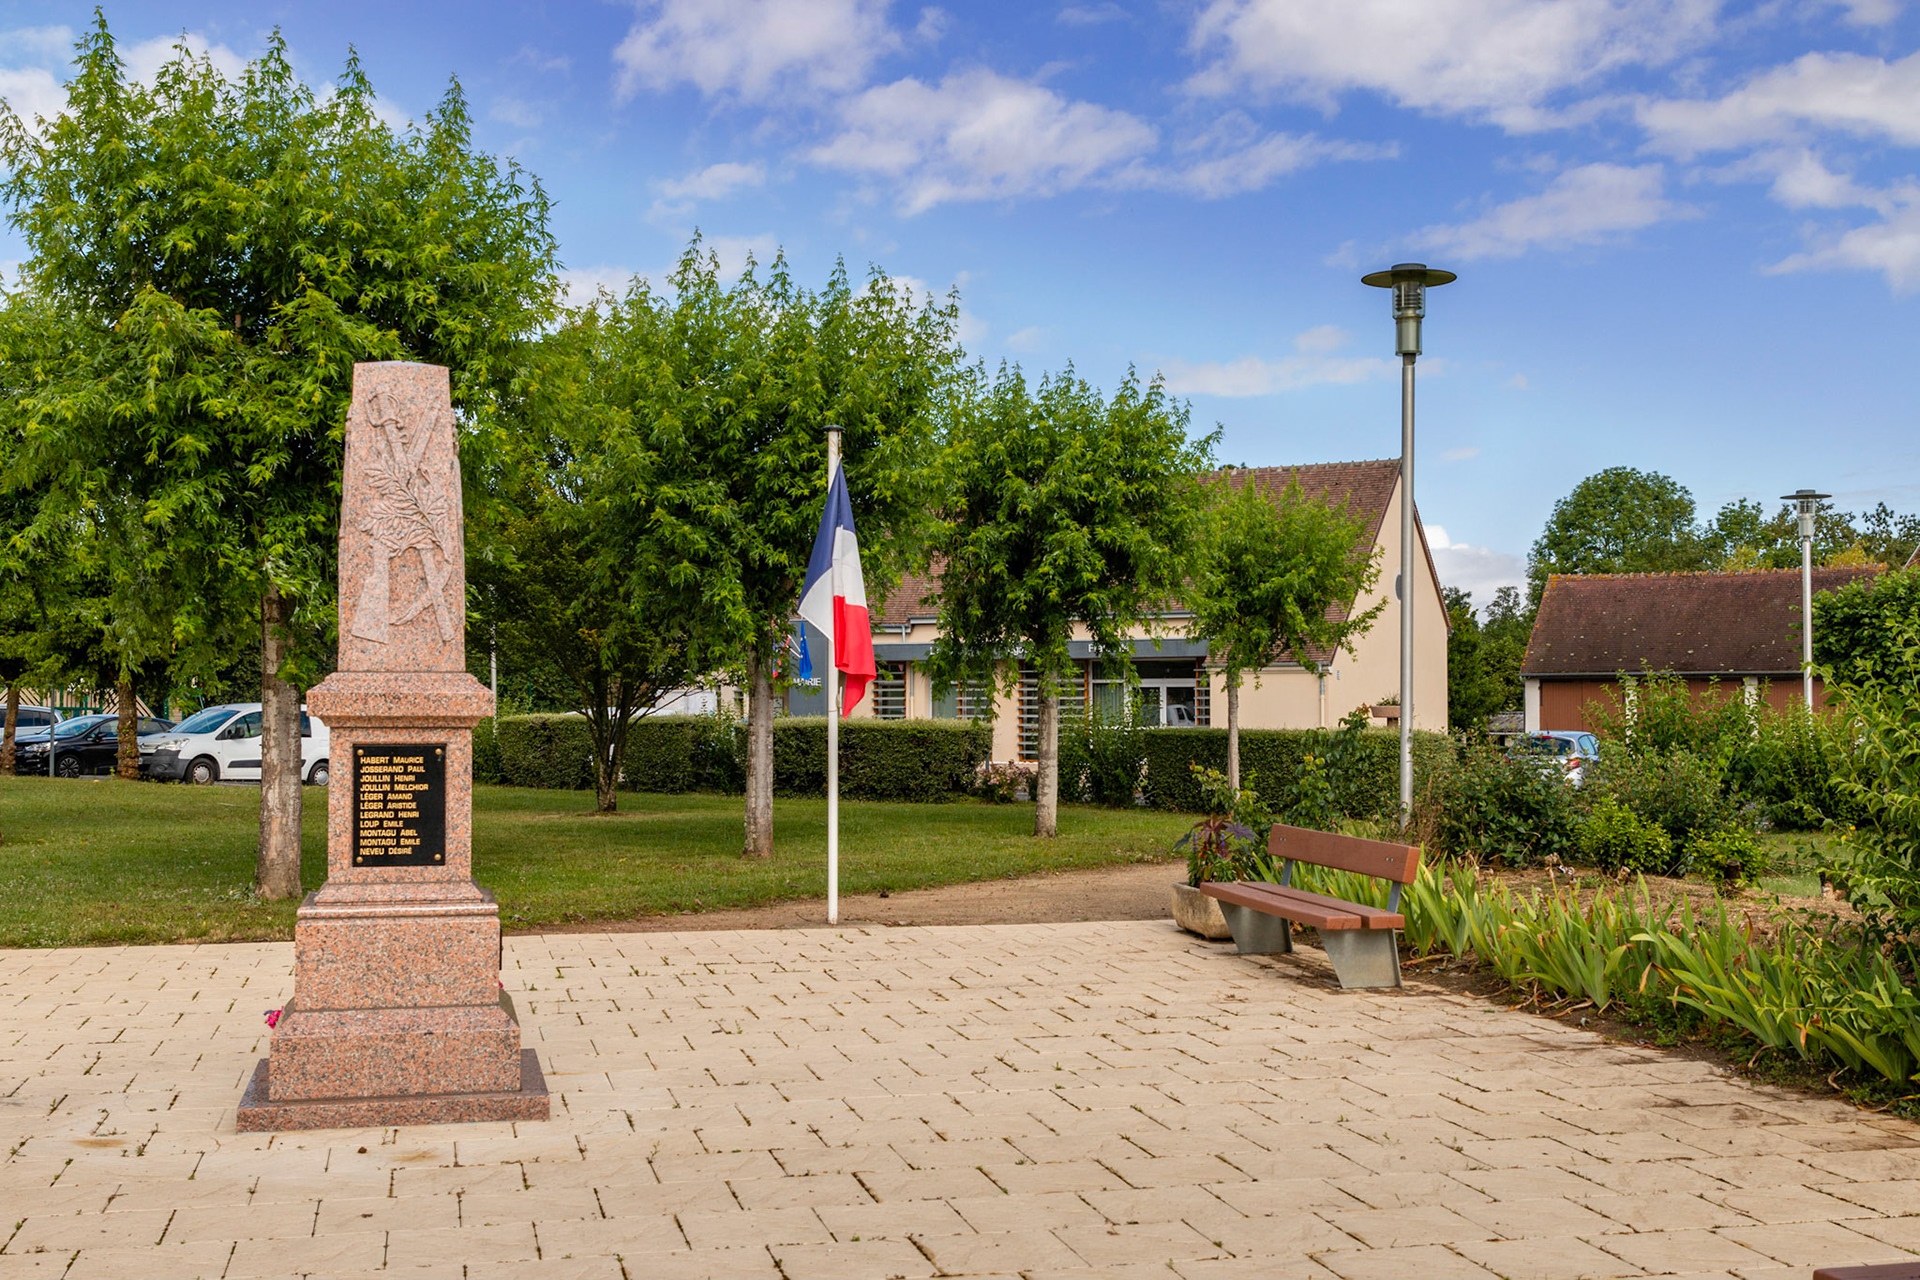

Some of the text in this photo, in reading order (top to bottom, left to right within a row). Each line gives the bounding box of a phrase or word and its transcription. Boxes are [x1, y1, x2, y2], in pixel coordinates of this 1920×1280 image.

[360, 756, 390, 764] HABERT
[360, 764, 426, 774] JOSSERAND PAUL
[360, 774, 416, 782] JOULLIN HENRI
[360, 784, 428, 792] JOULLIN MELCHIOR
[360, 792, 412, 800] LÉGER AMAND
[360, 800, 416, 810] LÉGER ARISTIDE
[360, 810, 420, 818] LEGRAND HENRI
[360, 820, 380, 828] LOUP
[360, 828, 418, 838] MONTAGU ABEL
[360, 838, 396, 846] MONTAGU
[360, 848, 384, 856] NEVEU
